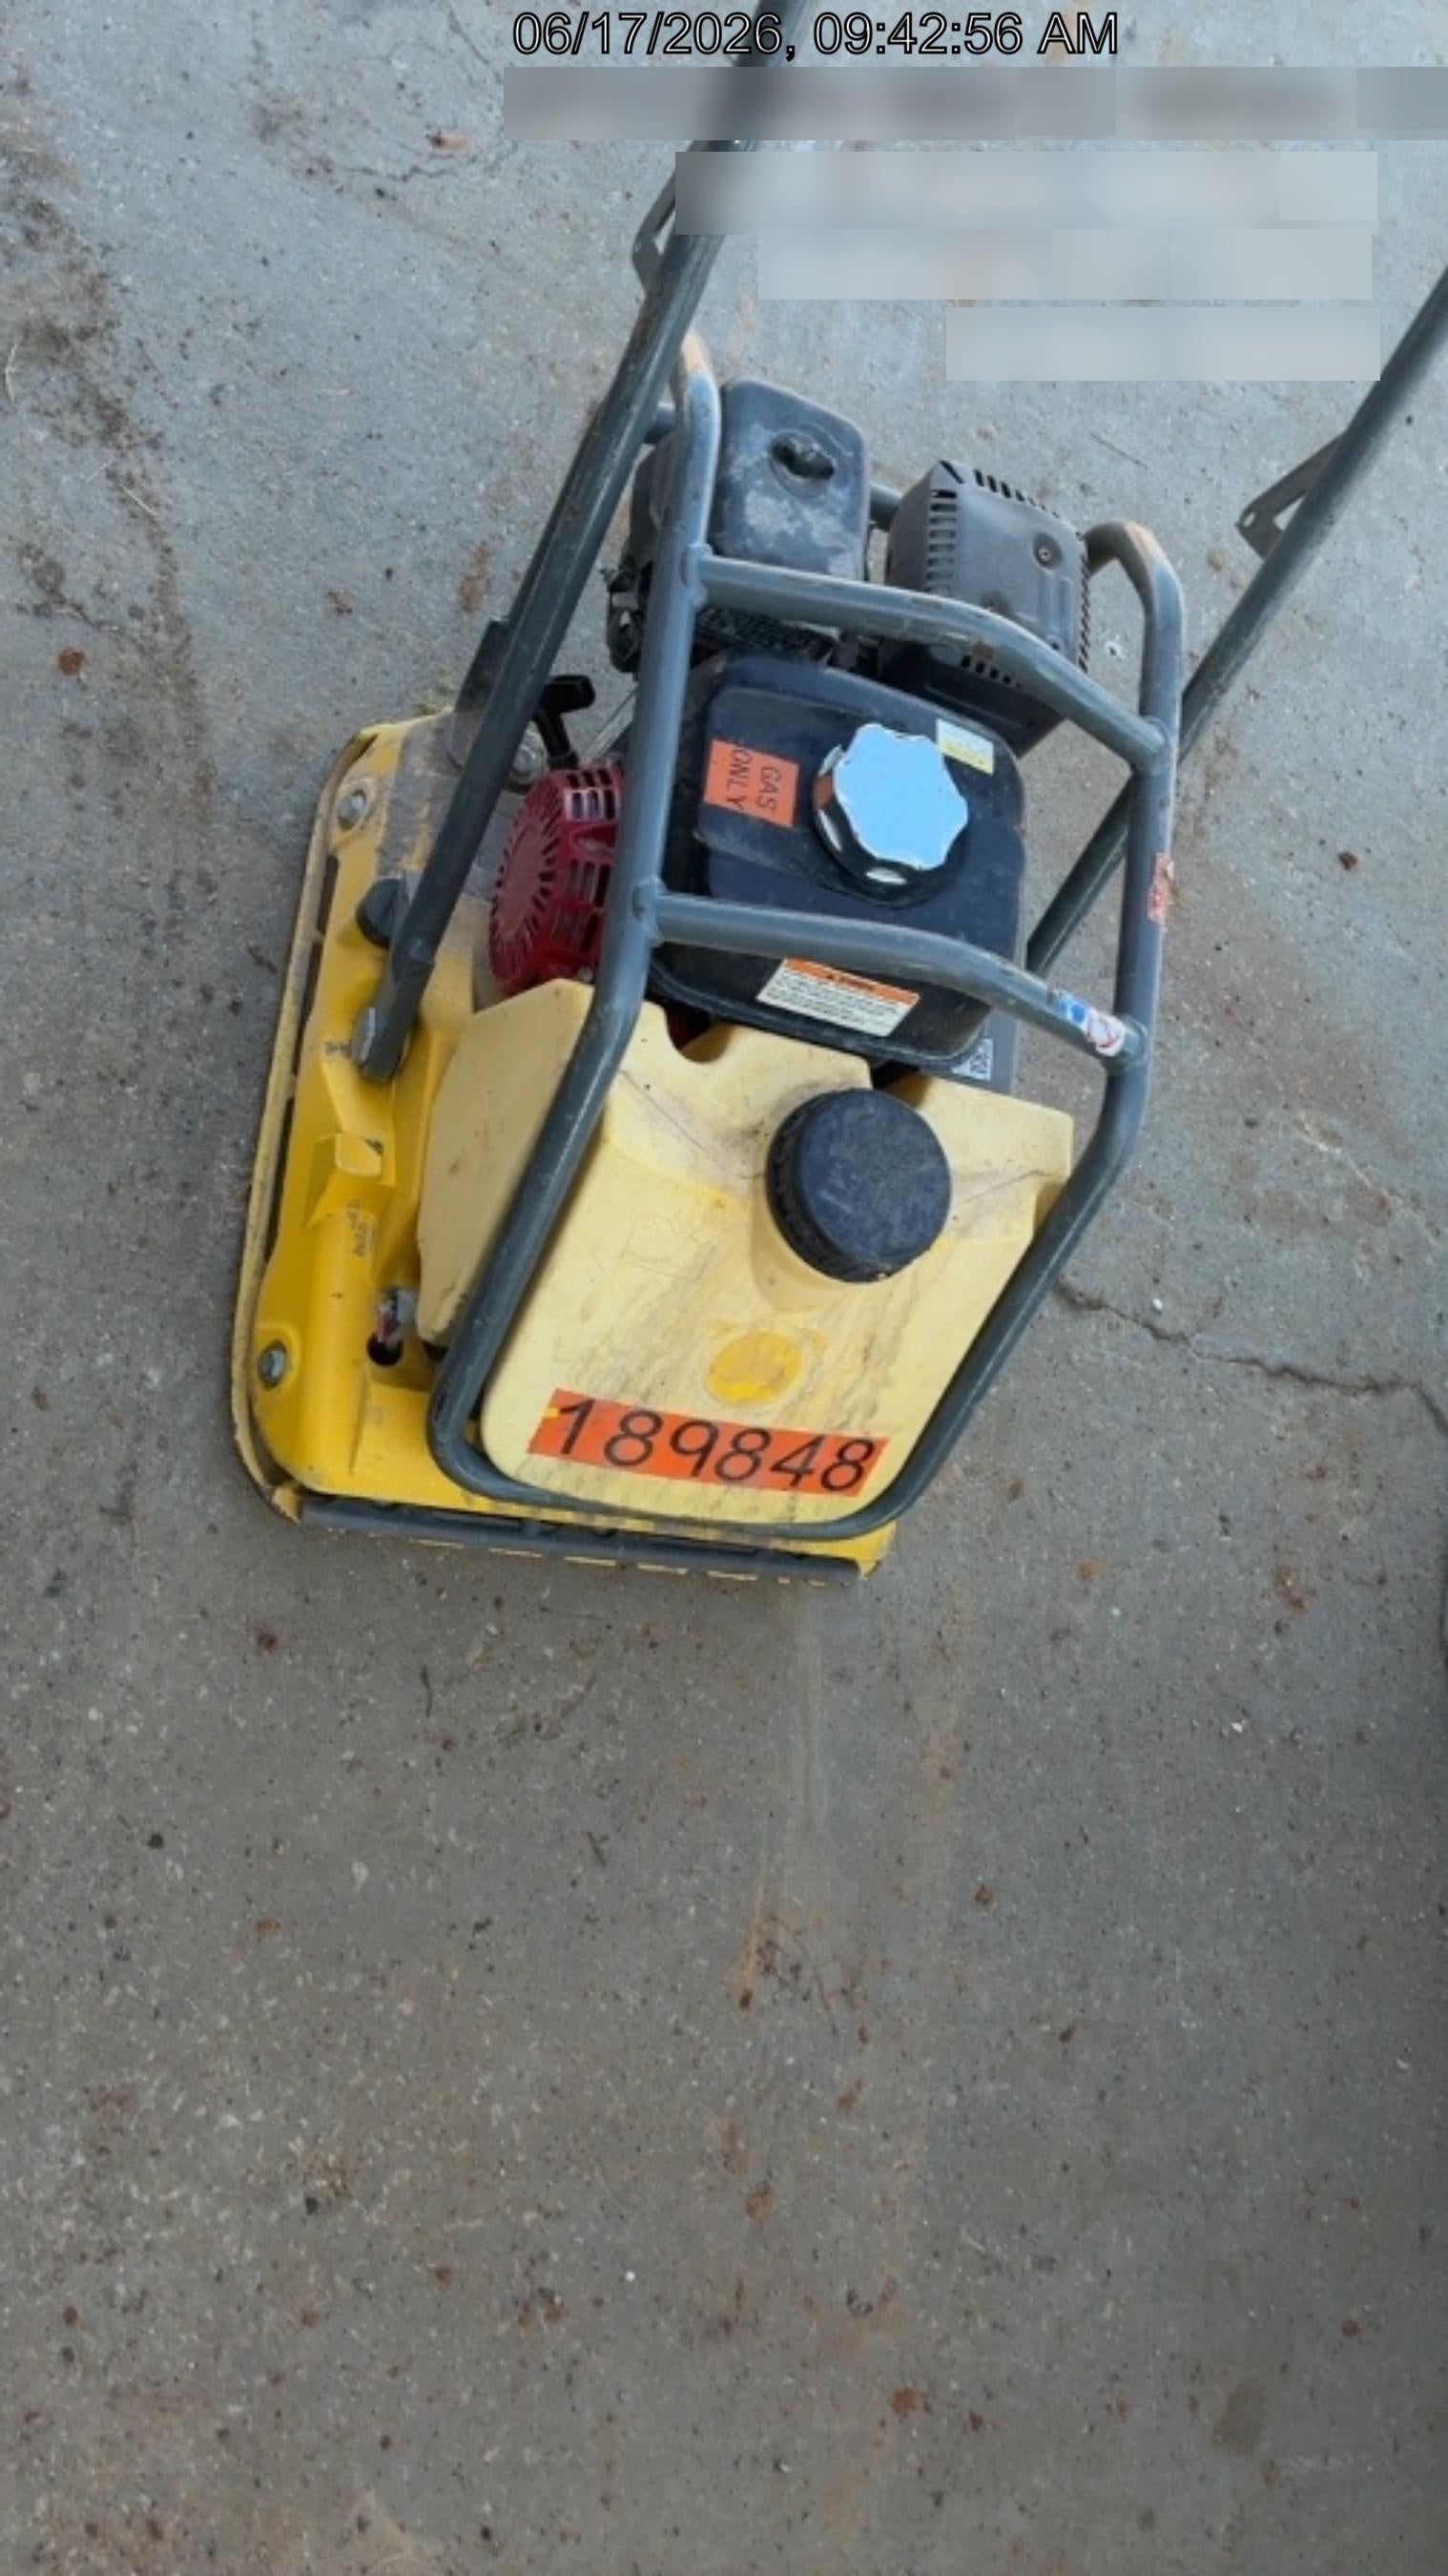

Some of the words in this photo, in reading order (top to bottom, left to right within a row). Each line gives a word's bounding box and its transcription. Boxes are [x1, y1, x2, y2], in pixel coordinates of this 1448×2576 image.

[725, 748, 753, 810] ONLY
[755, 766, 781, 811] GAS
[557, 1397, 875, 1492] 189848
